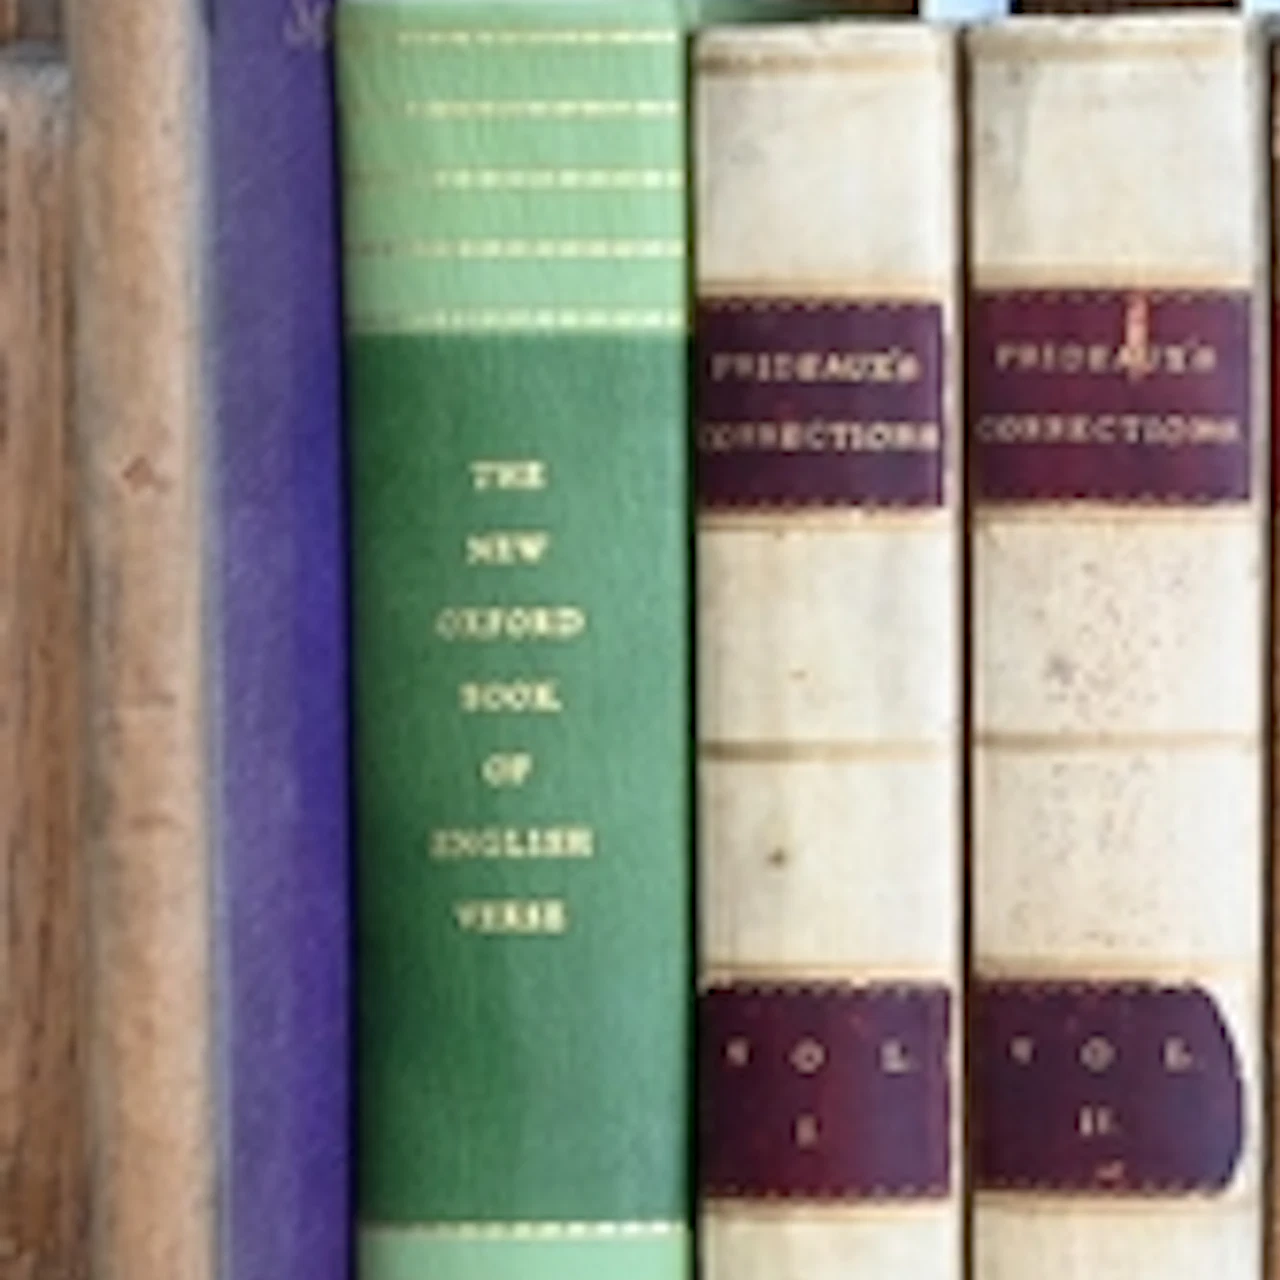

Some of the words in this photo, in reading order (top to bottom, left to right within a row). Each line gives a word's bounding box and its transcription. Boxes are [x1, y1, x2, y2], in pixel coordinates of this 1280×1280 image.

[470, 460, 547, 490] THE
[466, 530, 549, 565] NEW
[435, 606, 588, 640] OXFORD
[459, 678, 563, 712] BOOK
[481, 753, 533, 786] OF
[429, 826, 595, 858] ENGLISH
[453, 898, 568, 933] VERSE
